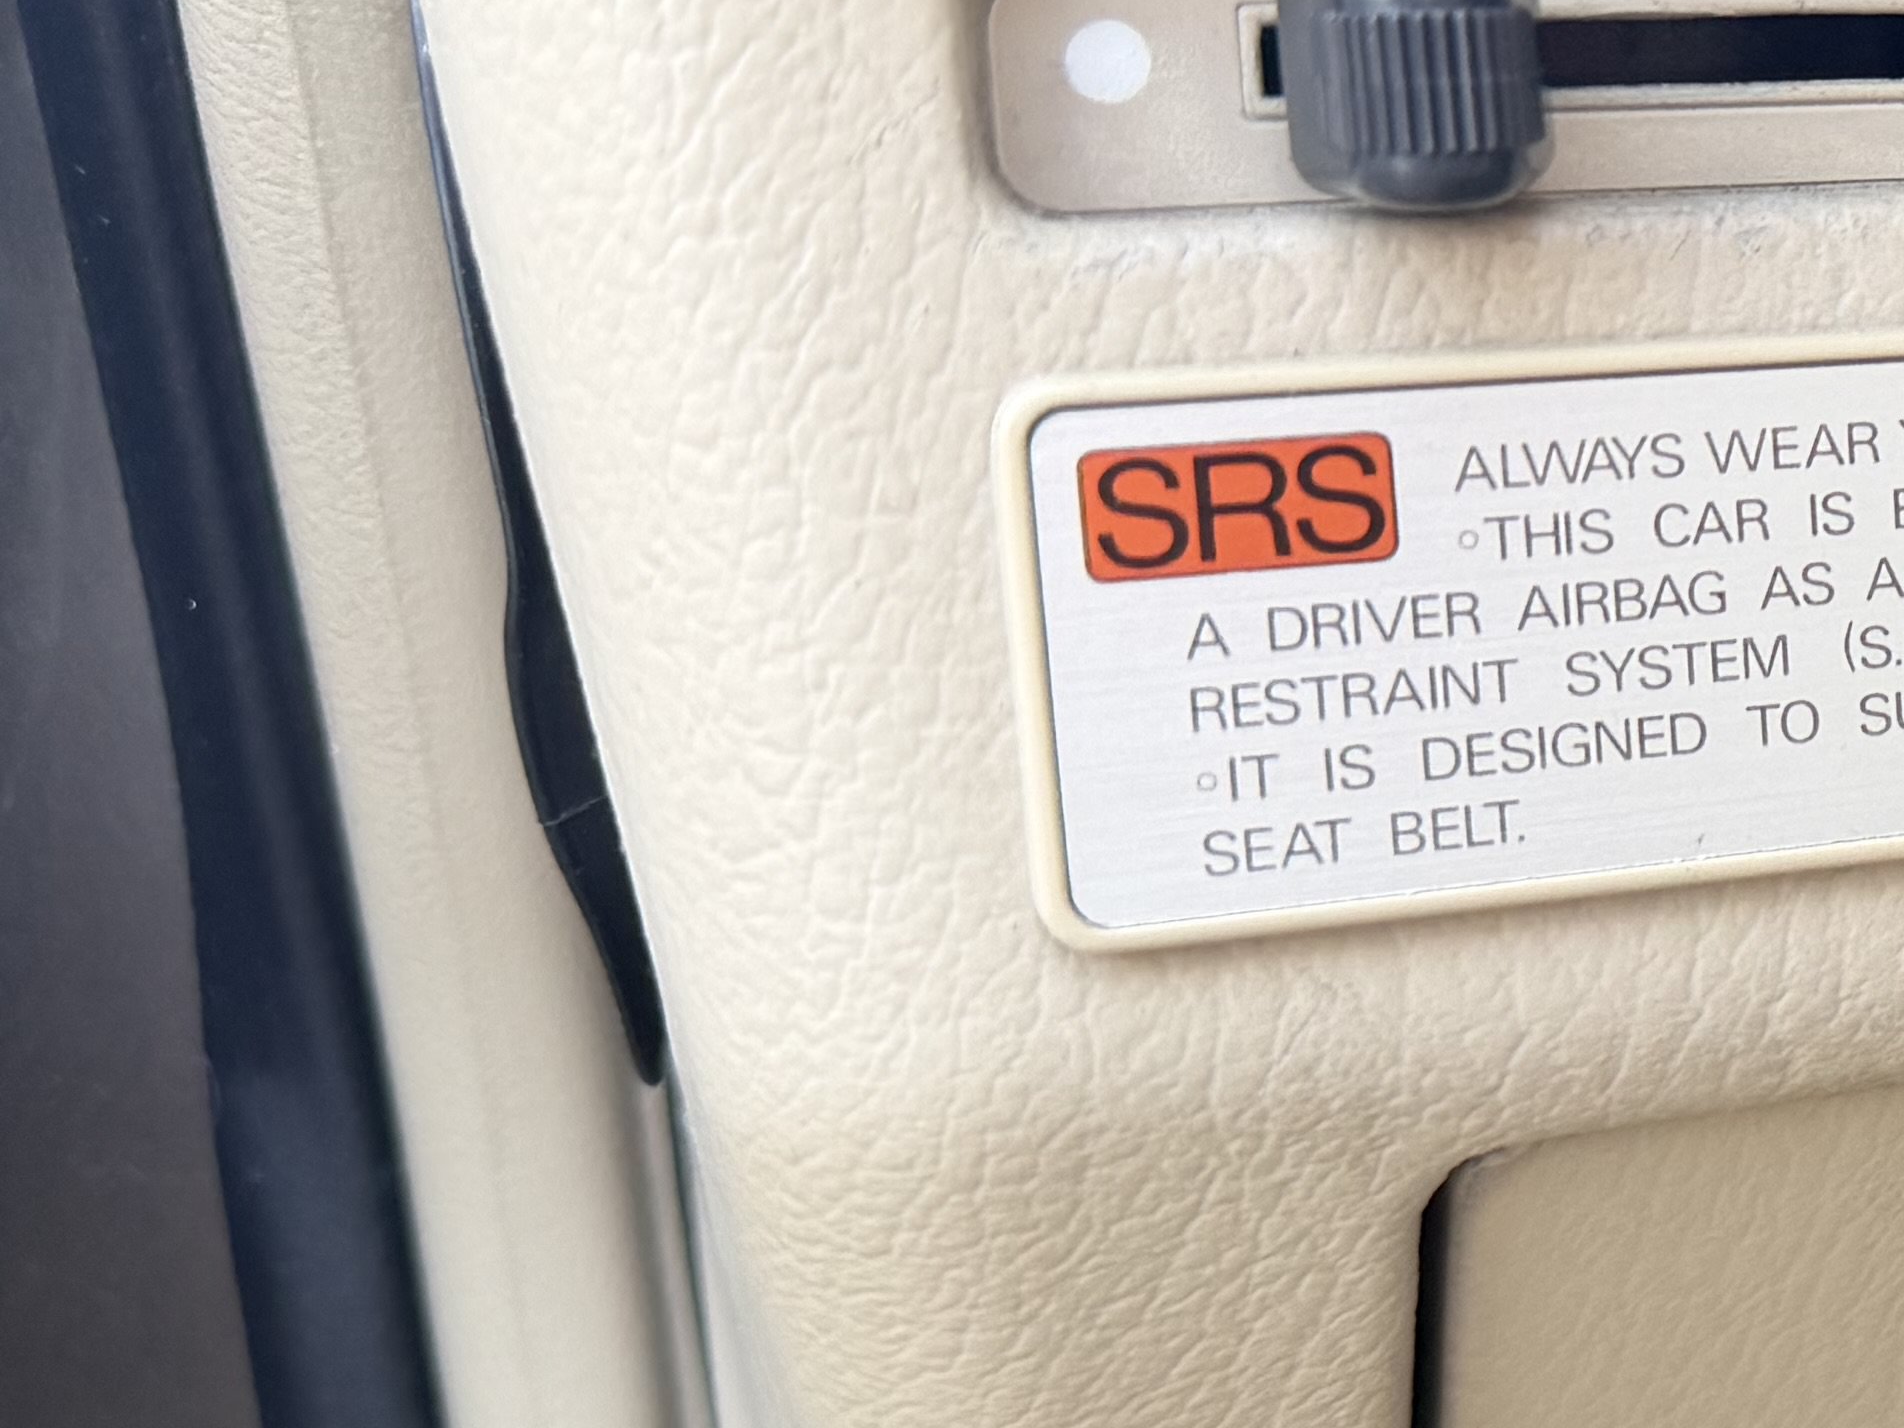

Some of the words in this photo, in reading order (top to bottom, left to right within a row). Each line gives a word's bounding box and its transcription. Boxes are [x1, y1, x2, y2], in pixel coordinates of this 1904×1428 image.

[1455, 433, 1685, 492] ALWAYS
[1704, 422, 1880, 474] WEAR
[1098, 446, 1385, 568] SRS
[1654, 499, 1770, 547] CAR
[1810, 491, 1855, 537] IS
[1187, 613, 1230, 660] A
[1268, 592, 1481, 652] DRIVER
[1518, 570, 1726, 631] AIRBAG
[1761, 562, 1834, 610] AS
[1866, 557, 1904, 601] A
[1190, 659, 1518, 732] RESTRAINT
[1566, 634, 1789, 697] SYSTEM
[1325, 744, 1375, 792] IS
[1422, 713, 1707, 781] DESIGNED
[1746, 700, 1819, 746] TO
[1203, 818, 1351, 876] SEAT
[1391, 799, 1525, 855] BELT.
